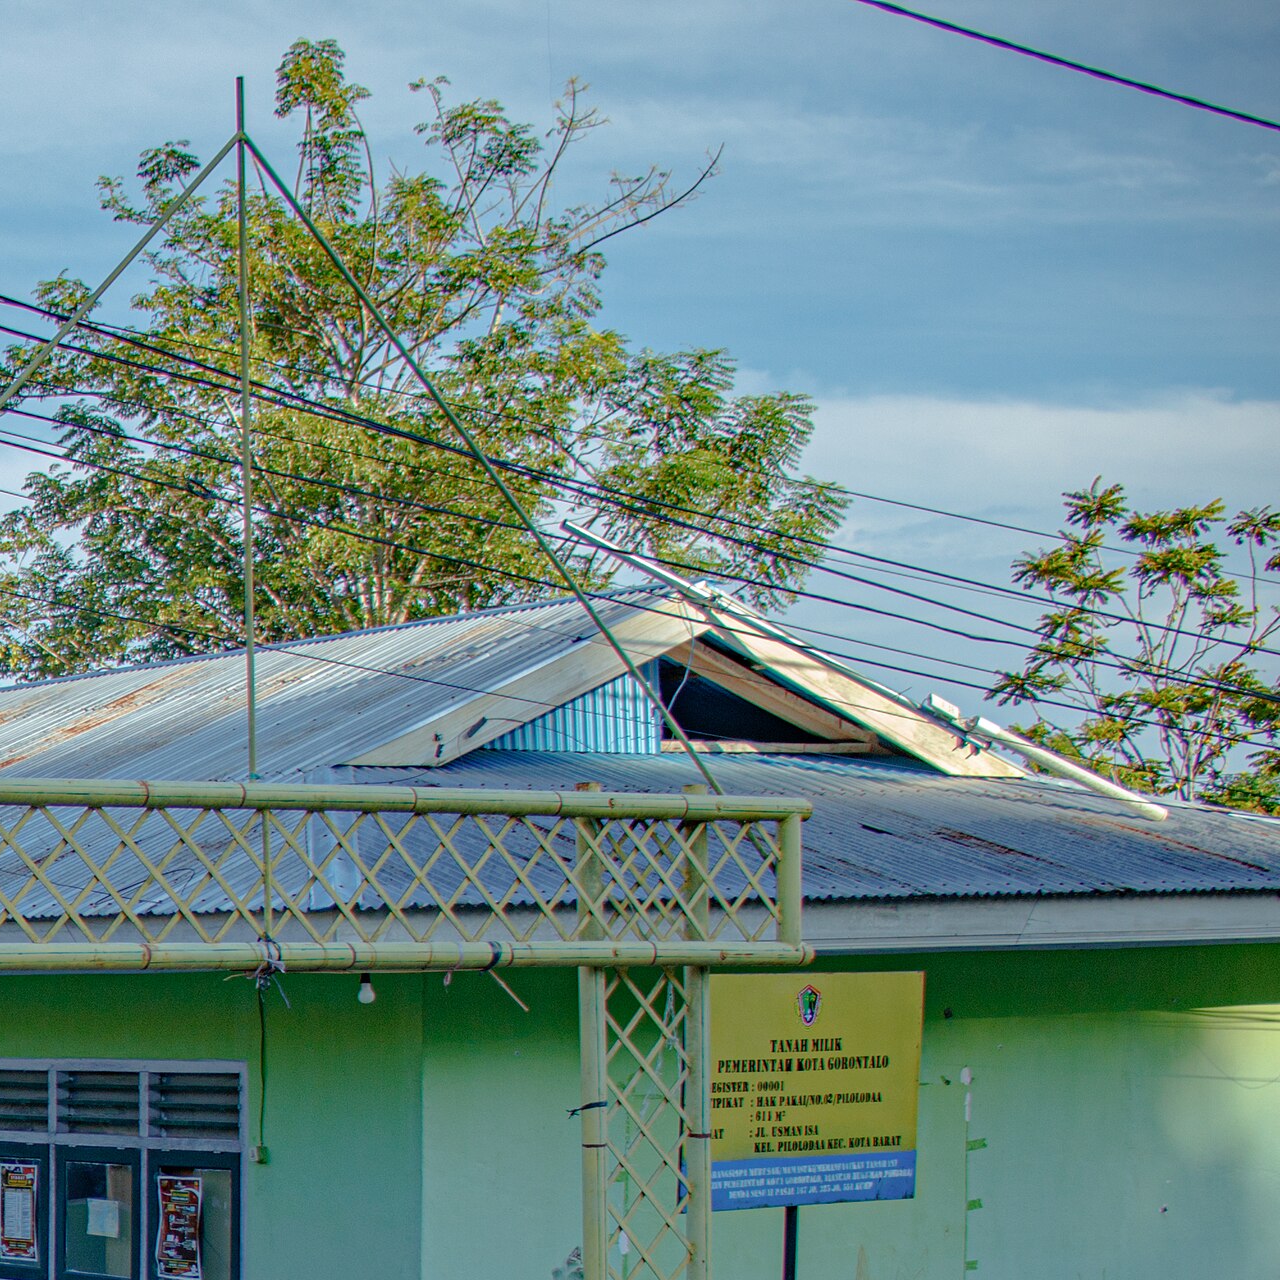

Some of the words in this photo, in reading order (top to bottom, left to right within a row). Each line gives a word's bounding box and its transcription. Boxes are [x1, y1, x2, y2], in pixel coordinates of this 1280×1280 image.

[770, 1040, 808, 1053] TANAH
[811, 1038, 842, 1052] MILIK
[717, 1058, 793, 1073] PEMERINTAH
[796, 1058, 825, 1072] KOTA
[827, 1055, 889, 1070] GORONTALO
[711, 1081, 749, 1093] EGISTER
[757, 1080, 784, 1091] 00001
[756, 1096, 777, 1107] HAK
[771, 1126, 802, 1137] USMAN
[804, 1125, 818, 1136] ISA
[754, 1142, 775, 1153] KEL.
[778, 1140, 825, 1152] PILOLODAA
[827, 1138, 846, 1149] KEC.
[848, 1137, 870, 1148] KOTA
[873, 1136, 901, 1147] BARAT
